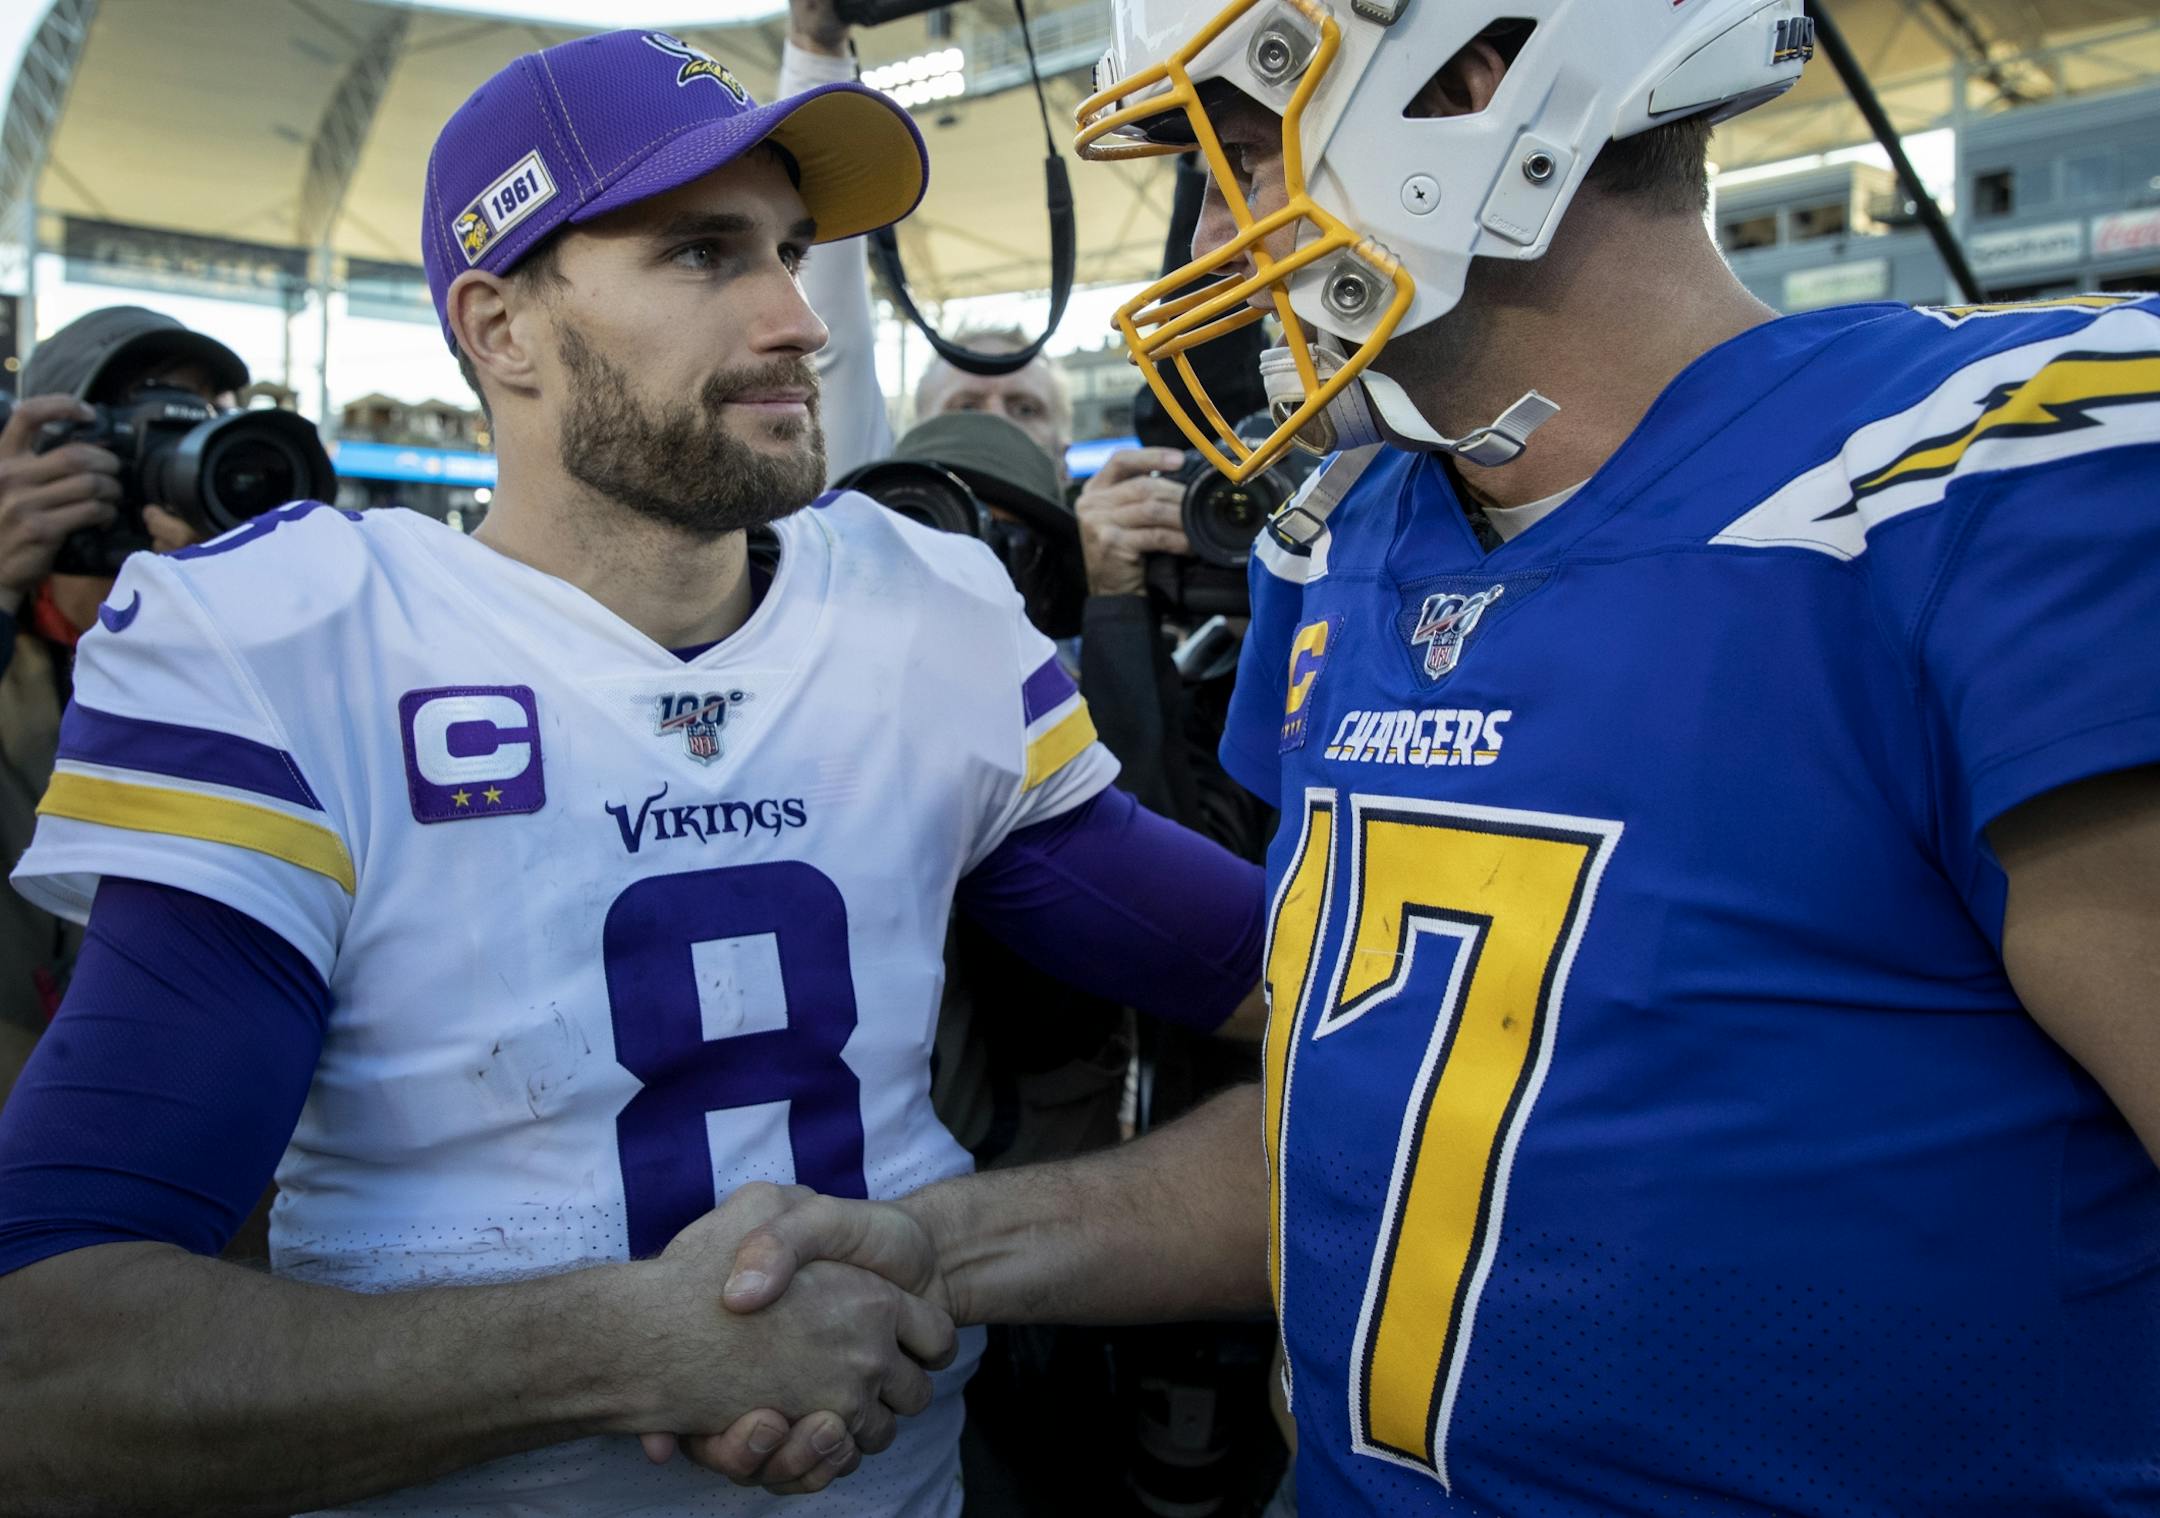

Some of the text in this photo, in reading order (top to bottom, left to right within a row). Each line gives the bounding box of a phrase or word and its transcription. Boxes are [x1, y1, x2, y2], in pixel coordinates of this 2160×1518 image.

[491, 168, 540, 221] 1961
[1286, 620, 1329, 715] C
[413, 695, 532, 786] C
[1324, 709, 1513, 768] CHARGERS
[603, 860, 869, 1262] 8
[1263, 786, 1625, 1498] 17
